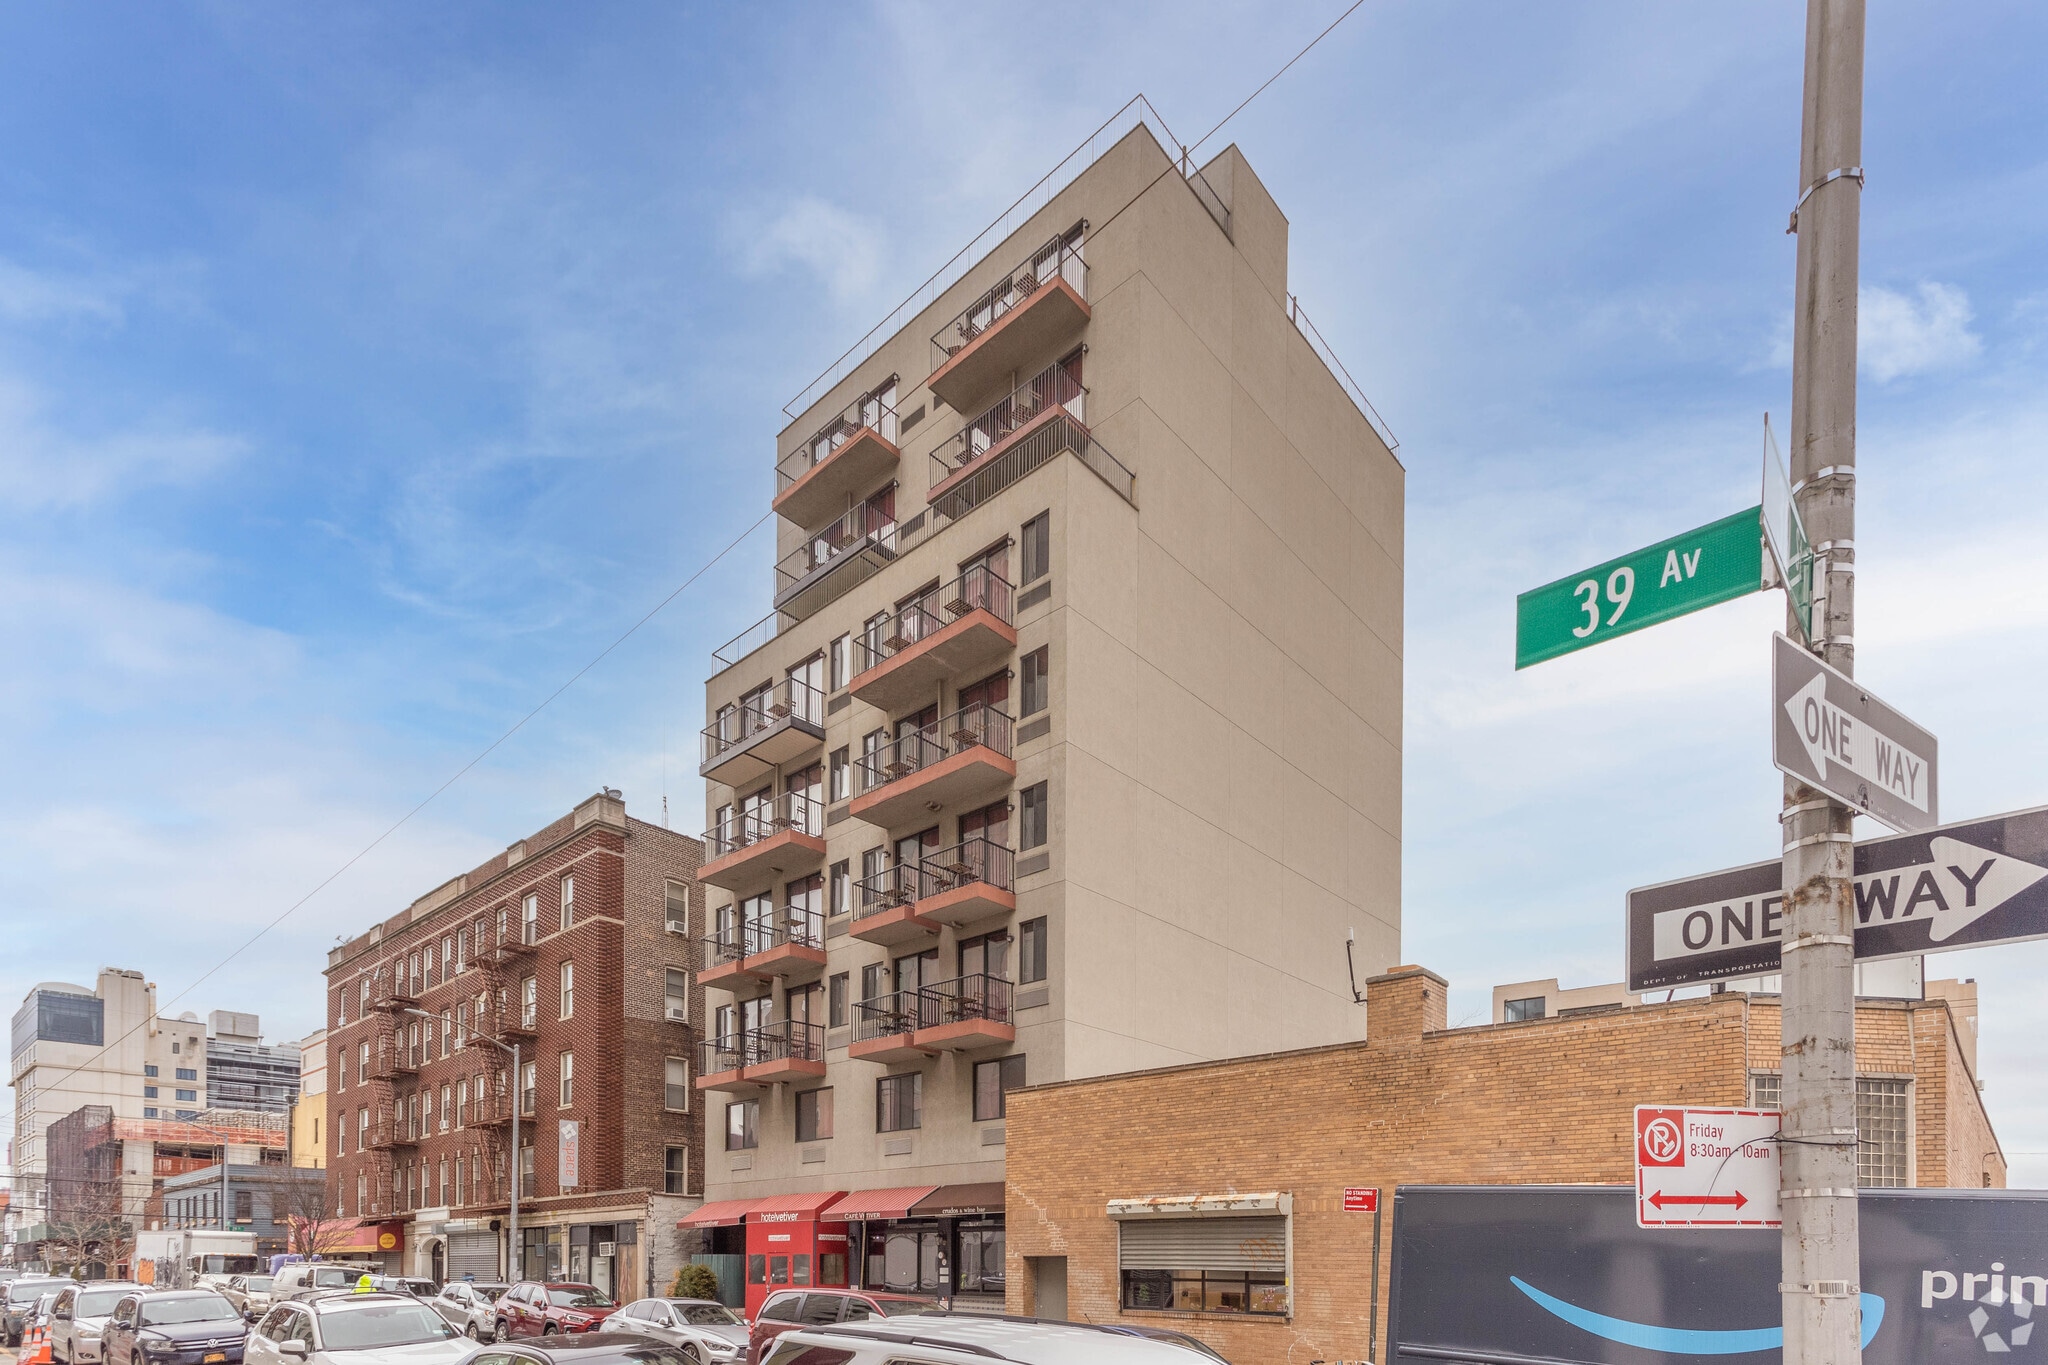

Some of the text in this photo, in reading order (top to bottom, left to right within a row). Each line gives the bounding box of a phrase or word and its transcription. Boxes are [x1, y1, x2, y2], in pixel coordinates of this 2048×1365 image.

[1572, 548, 1702, 639] 39 Av
[1804, 695, 1920, 801] ONE WAY
[1682, 858, 1998, 951] ONE WAY
[1643, 977, 1667, 986] DEPT
[1689, 1123, 1724, 1141] Friday
[562, 1141, 575, 1176] space
[1690, 1143, 1731, 1158] 8:30am
[1741, 1144, 1770, 1159] 10am
[760, 1211, 799, 1222] hotelvetiver
